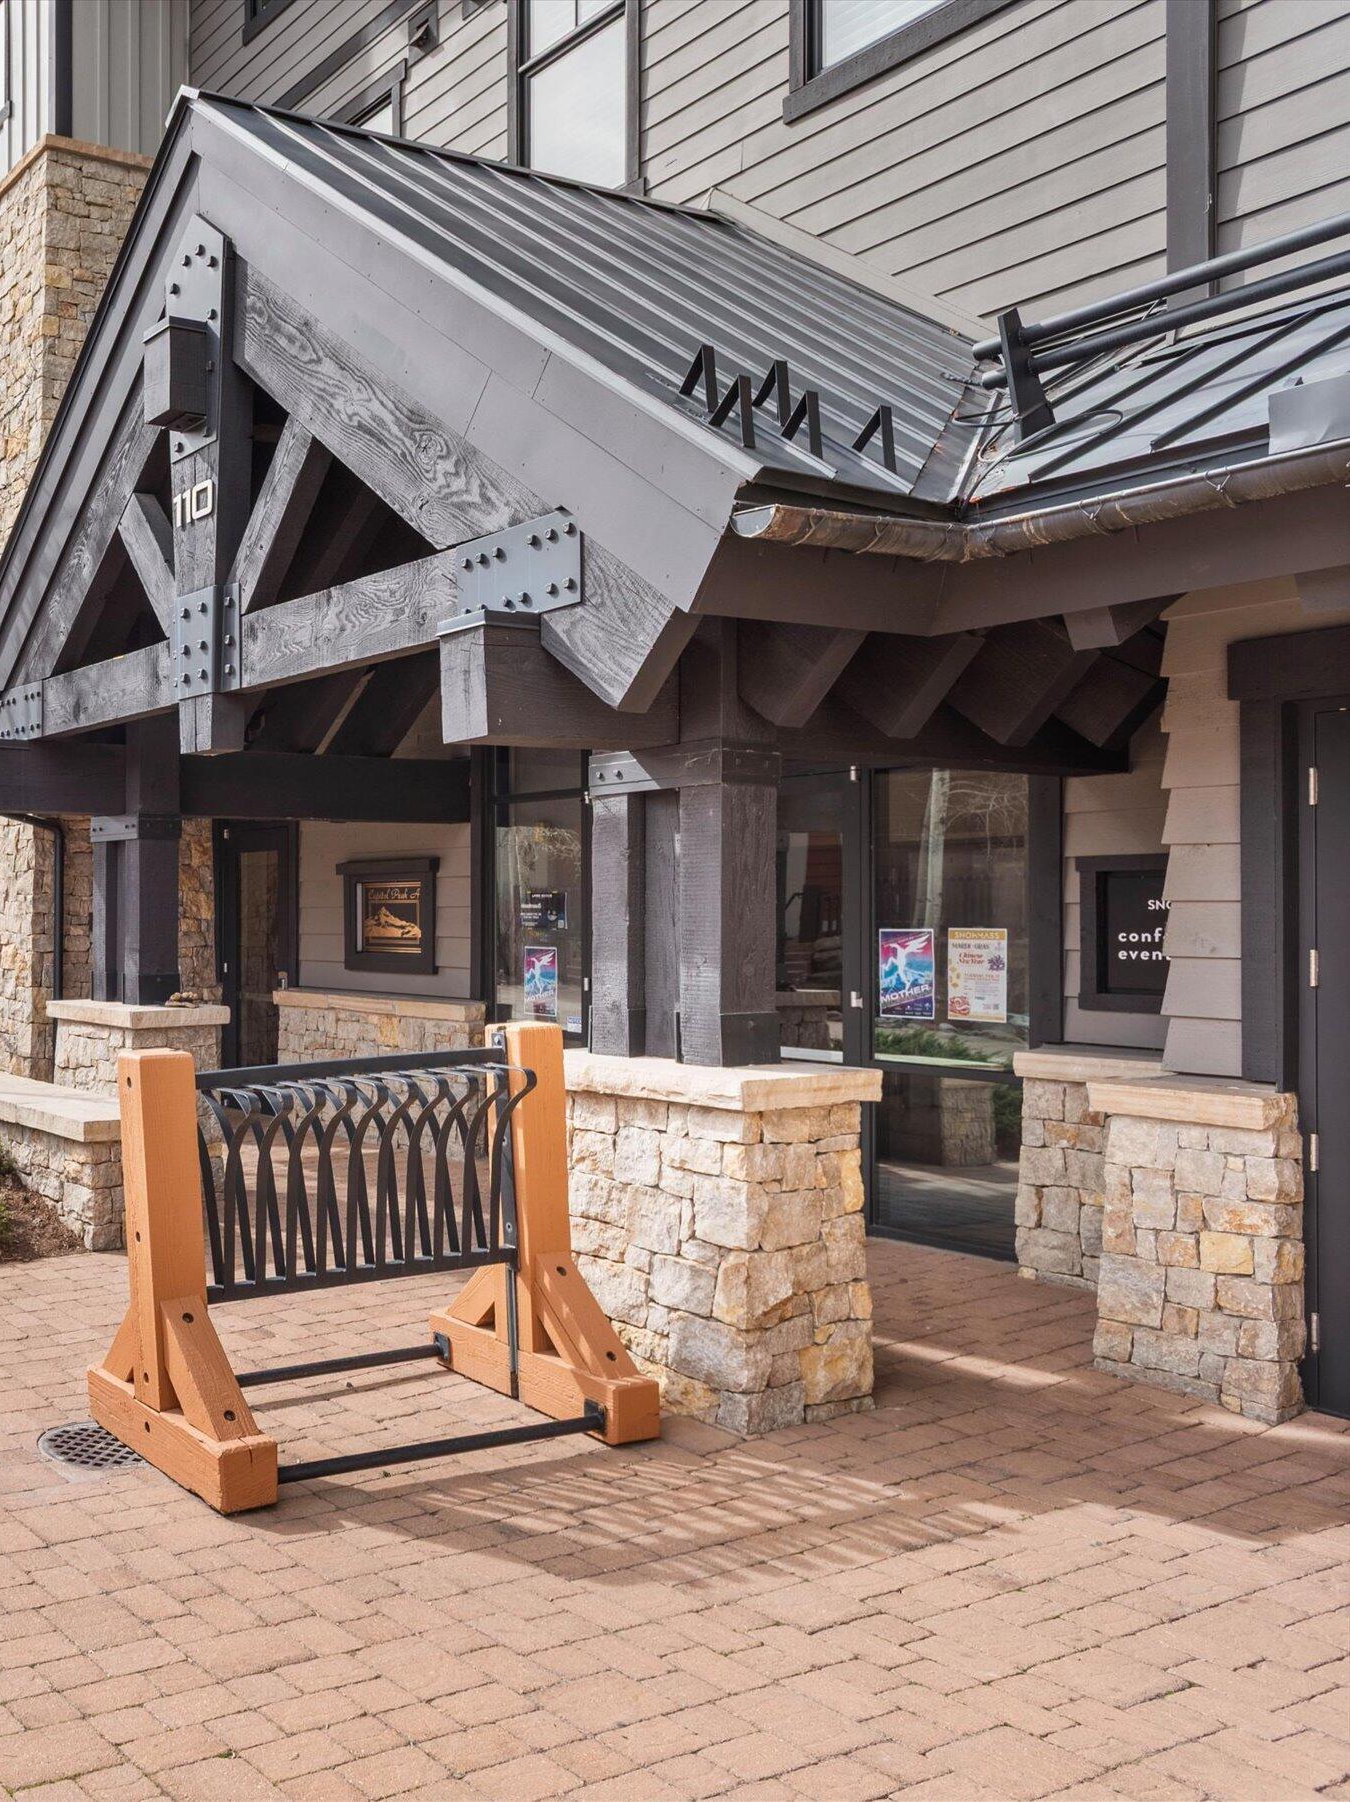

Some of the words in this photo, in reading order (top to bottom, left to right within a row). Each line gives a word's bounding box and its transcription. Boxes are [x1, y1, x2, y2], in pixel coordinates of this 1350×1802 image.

[173, 479, 213, 527] 110
[1118, 927, 1164, 942] conf
[1118, 950, 1172, 960] even
